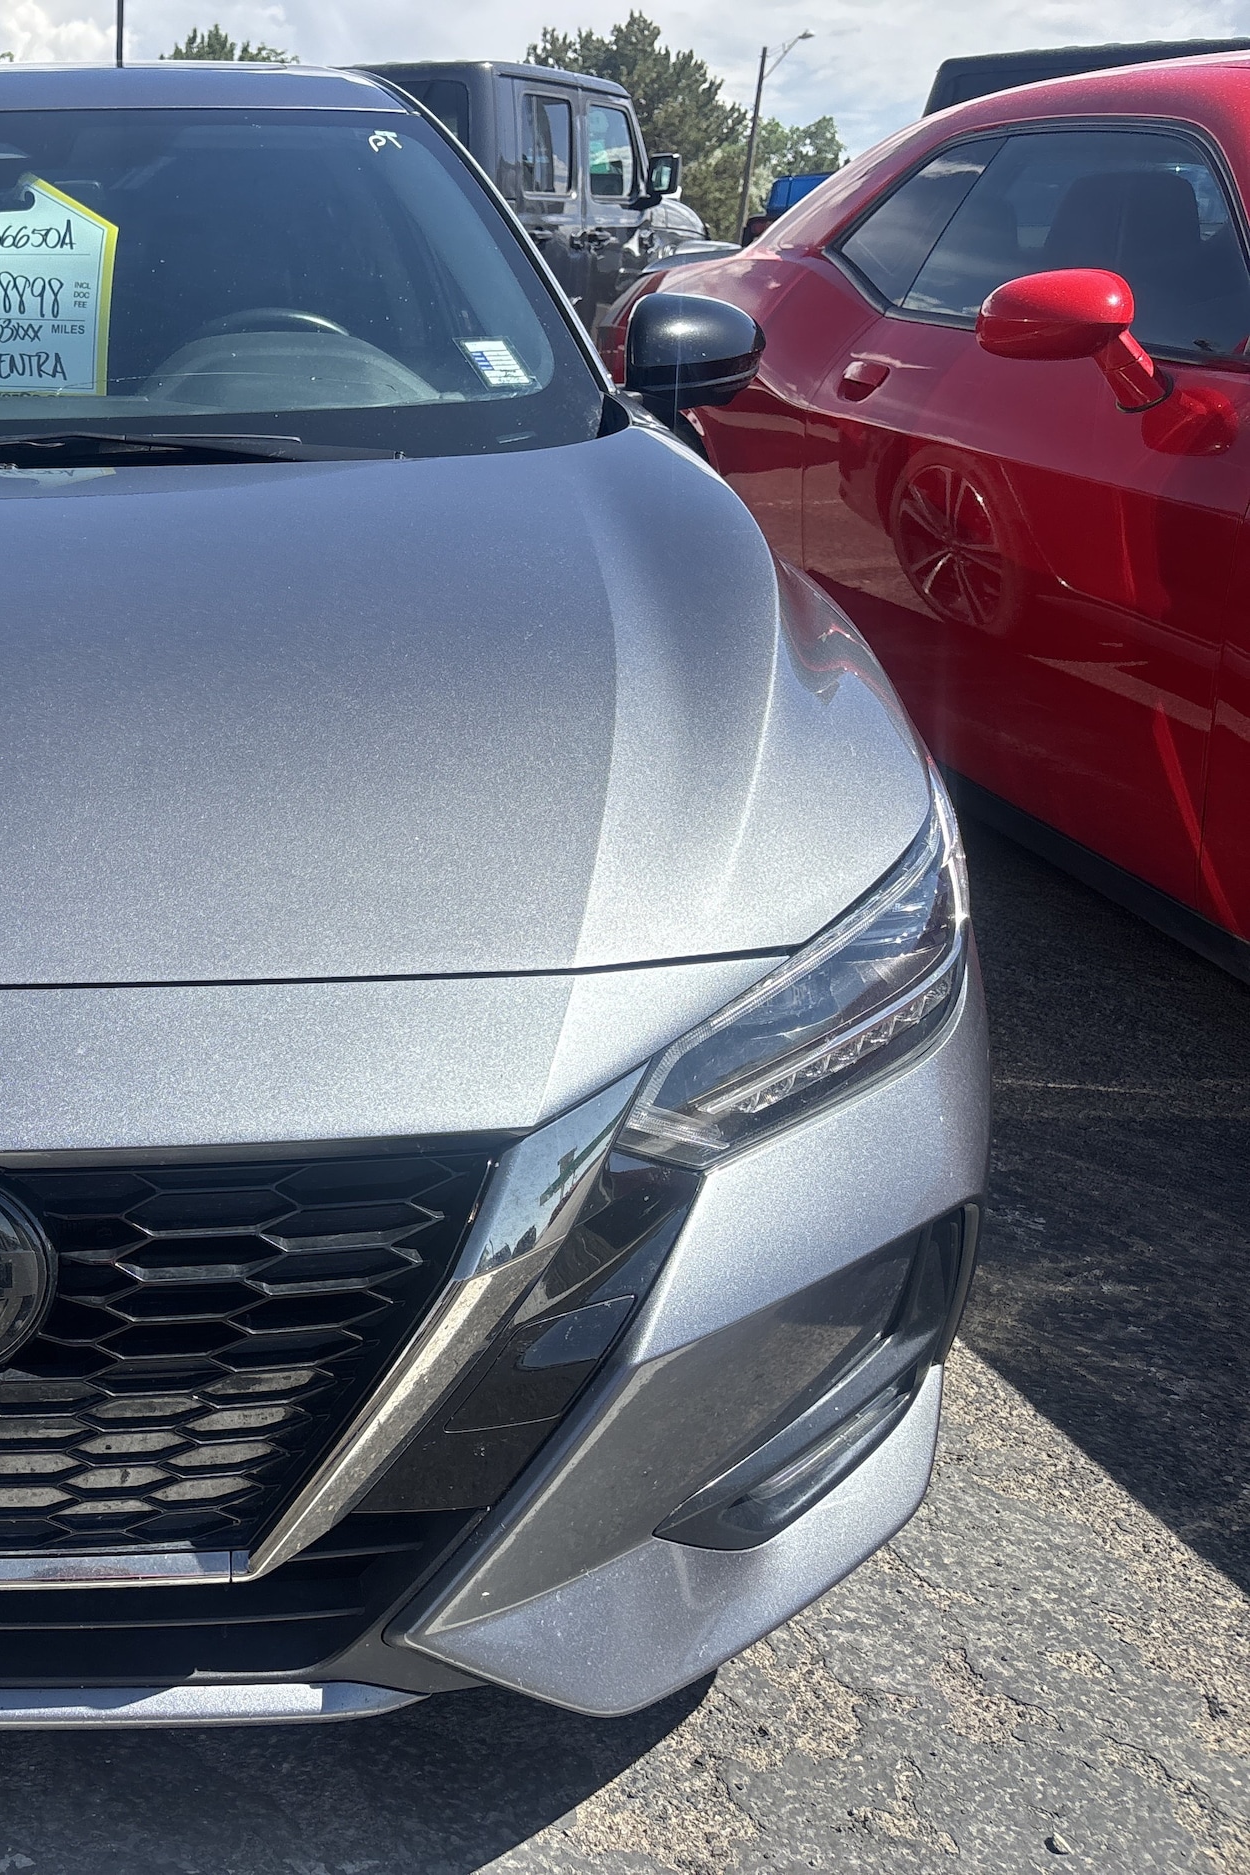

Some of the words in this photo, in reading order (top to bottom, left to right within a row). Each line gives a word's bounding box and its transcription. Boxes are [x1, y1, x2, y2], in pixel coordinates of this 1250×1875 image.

[74, 281, 91, 290] INCL
[73, 291, 90, 299] DOC
[73, 300, 88, 309] FEE
[51, 324, 86, 335] MILES
